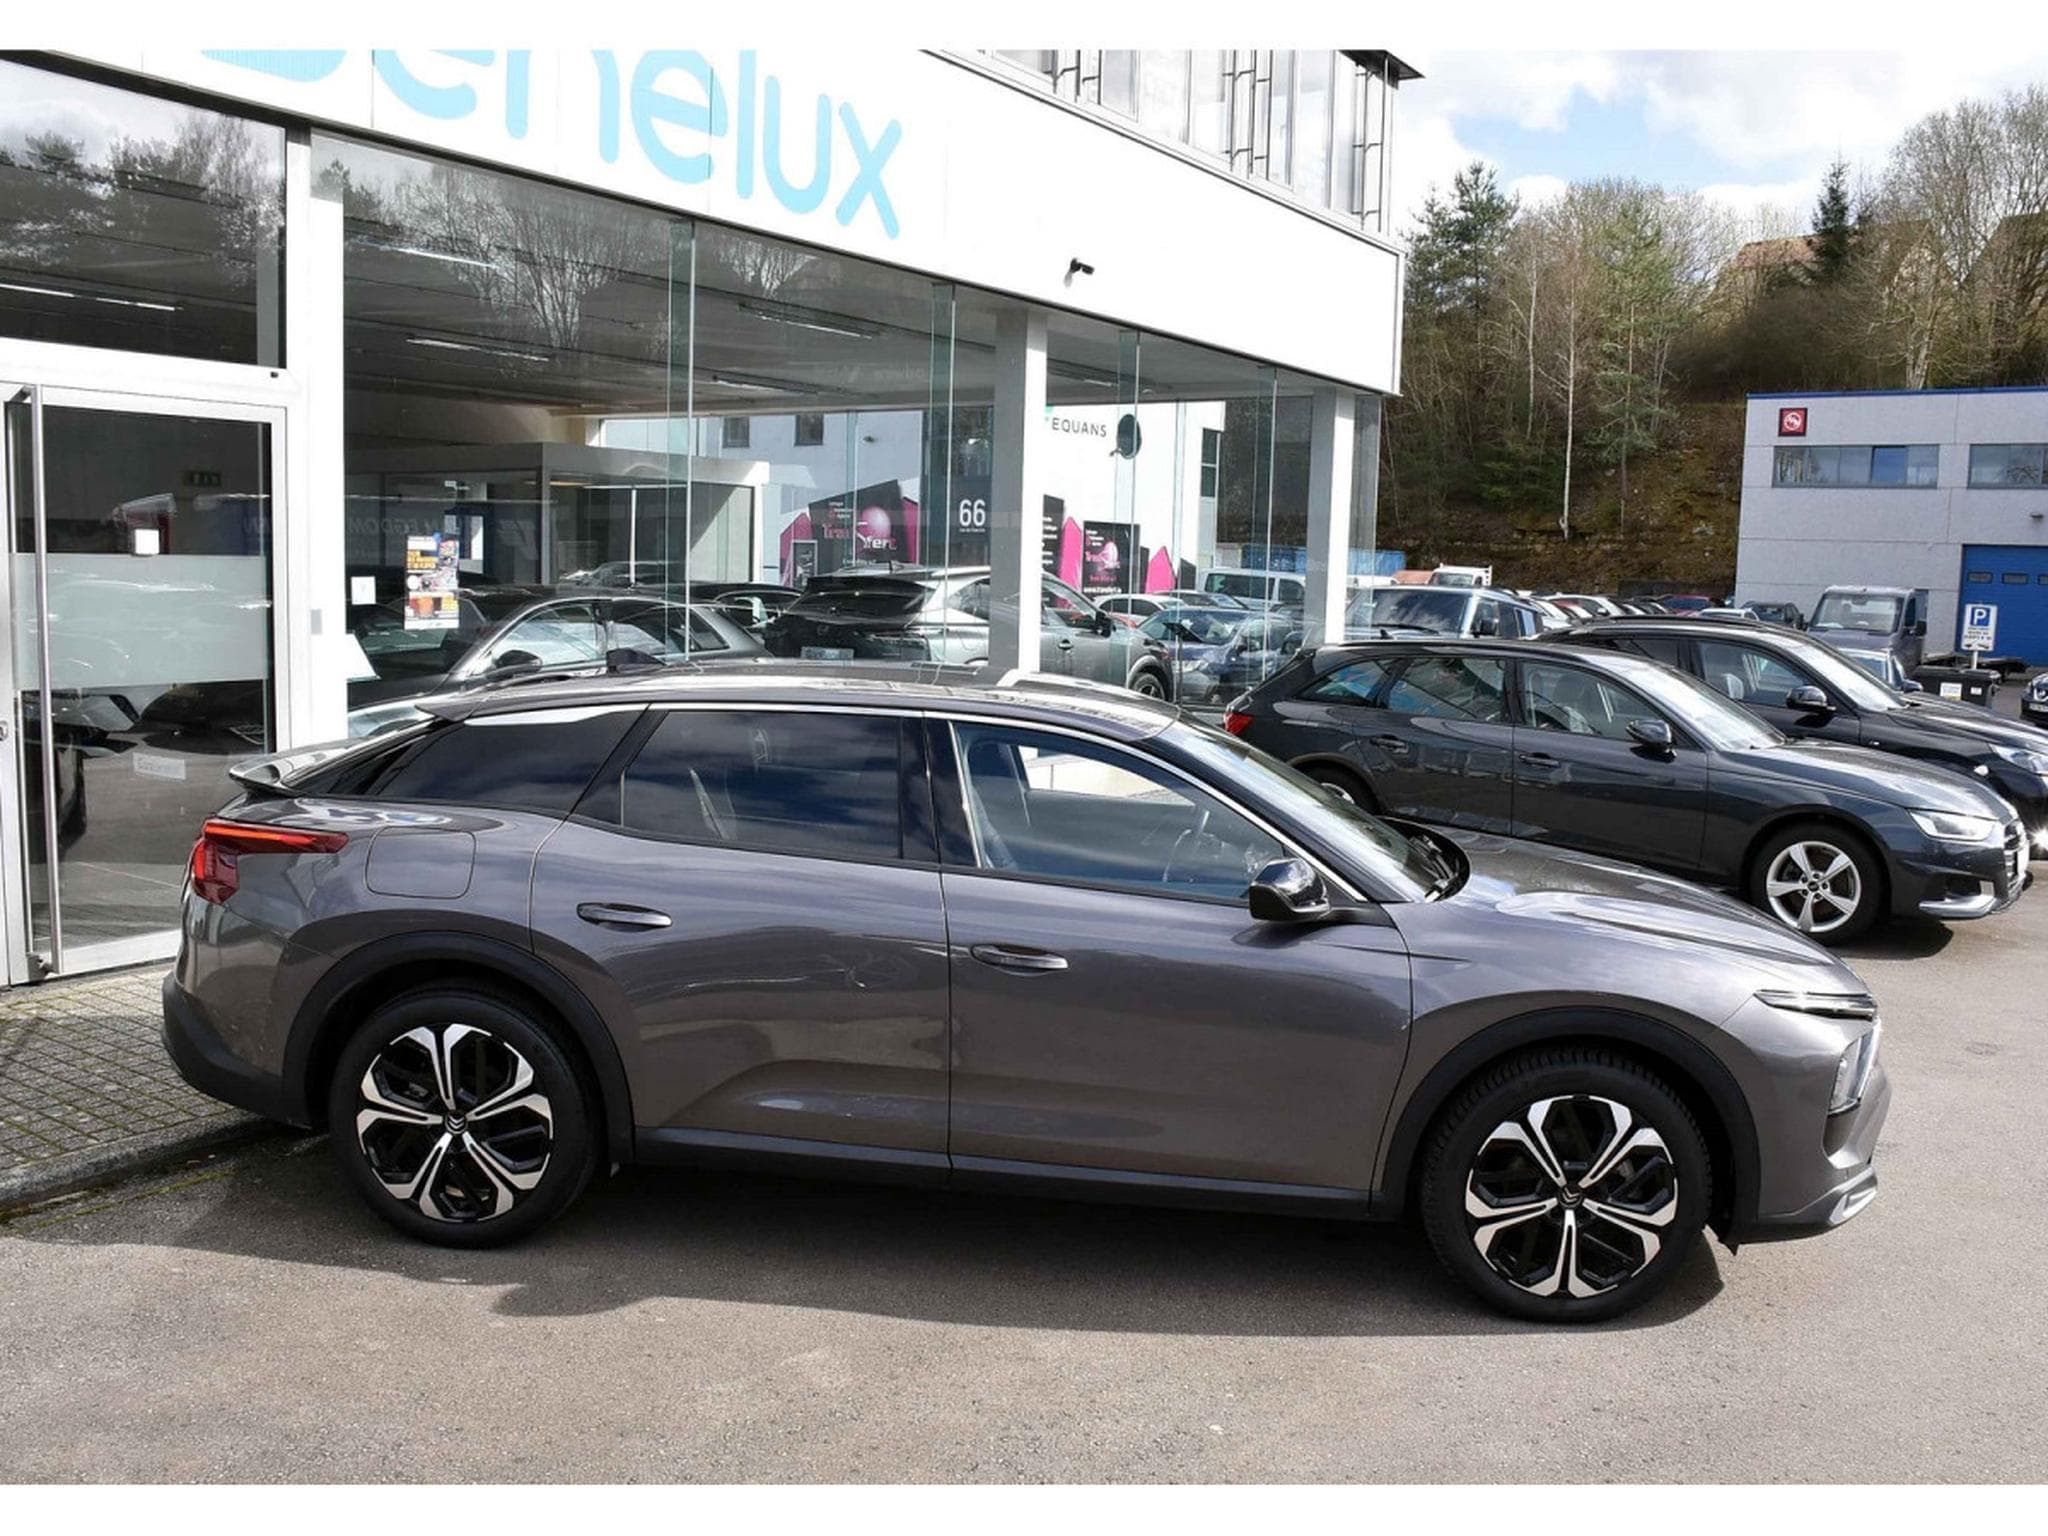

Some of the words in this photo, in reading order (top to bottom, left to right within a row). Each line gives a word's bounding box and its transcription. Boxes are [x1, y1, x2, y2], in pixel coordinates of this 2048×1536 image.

[200, 50, 902, 239] enelux
[1051, 416, 1108, 438] EQUANS
[959, 498, 986, 527] 66
[1974, 609, 1987, 625] P
